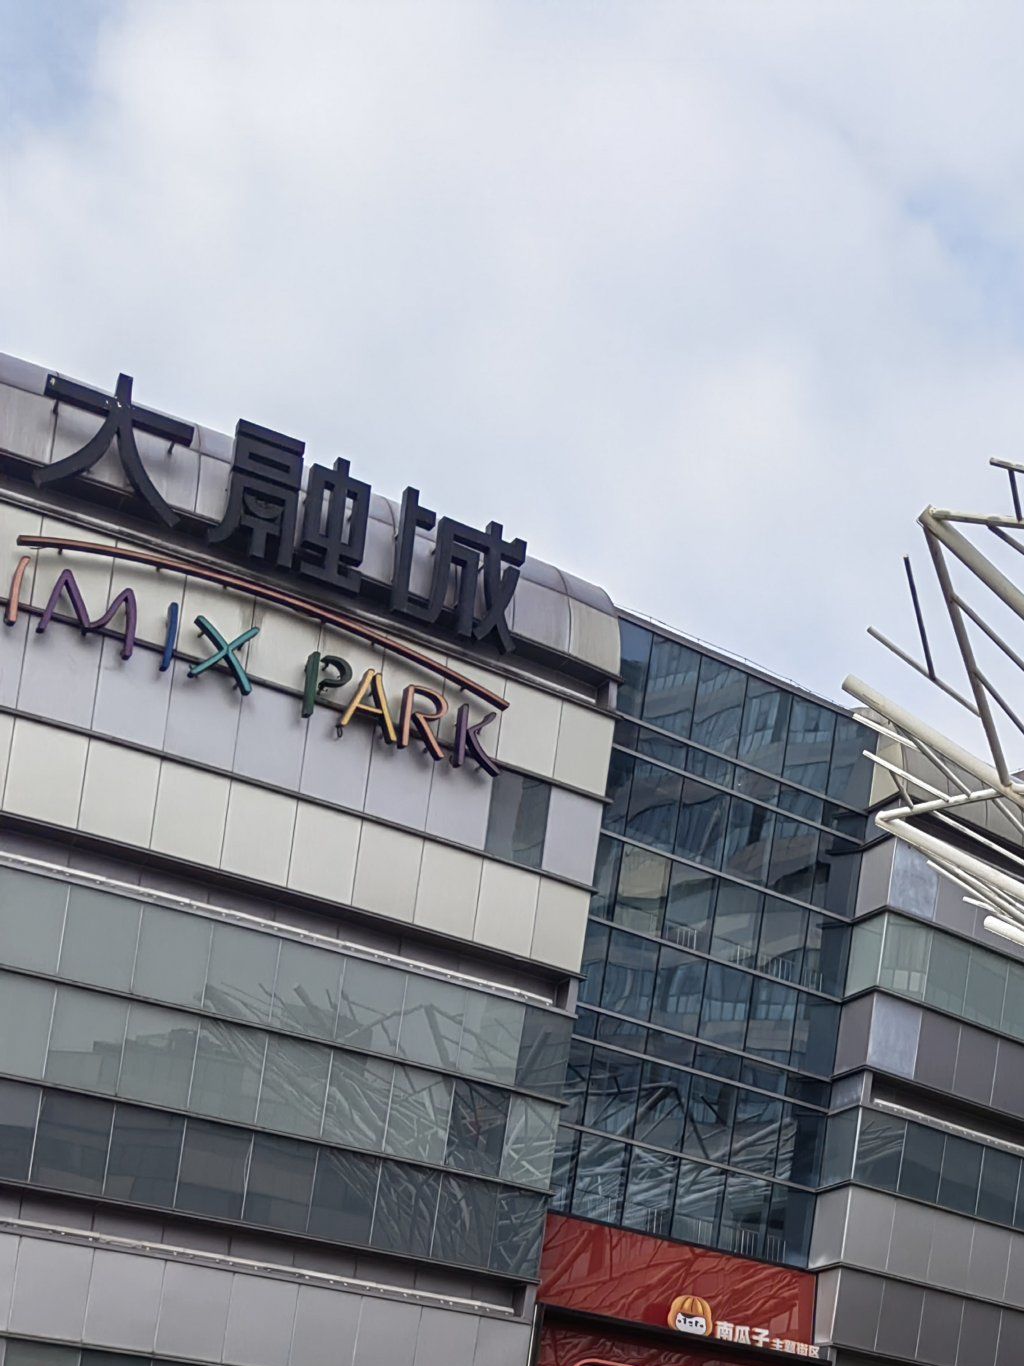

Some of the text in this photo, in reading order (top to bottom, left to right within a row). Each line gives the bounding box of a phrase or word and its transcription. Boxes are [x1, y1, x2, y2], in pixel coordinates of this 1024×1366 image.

[32, 372, 528, 655] 大融城
[301, 650, 501, 778] PARK
[714, 1320, 770, 1348] 南瓜子
